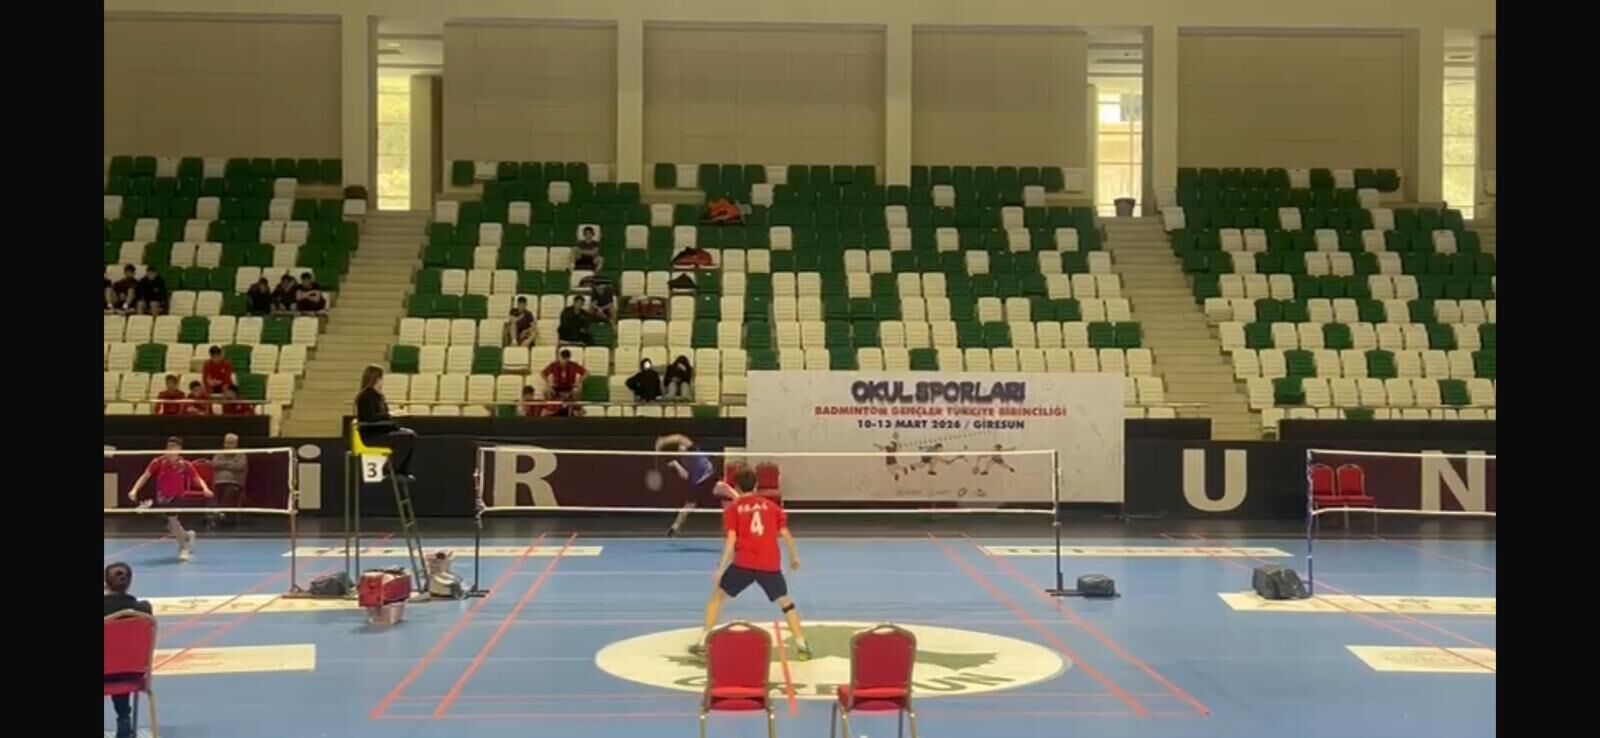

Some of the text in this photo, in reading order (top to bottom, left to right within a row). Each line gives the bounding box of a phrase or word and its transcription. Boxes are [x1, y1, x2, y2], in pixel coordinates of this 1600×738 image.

[851, 380, 1026, 403] OKUL SPORLARI
[858, 419, 892, 429] 10-13
[895, 419, 928, 429] MART
[931, 419, 961, 429] 2026
[367, 462, 378, 478] 3
[1183, 449, 1248, 512] U
[1421, 450, 1487, 512] N
[749, 510, 765, 537] 4
